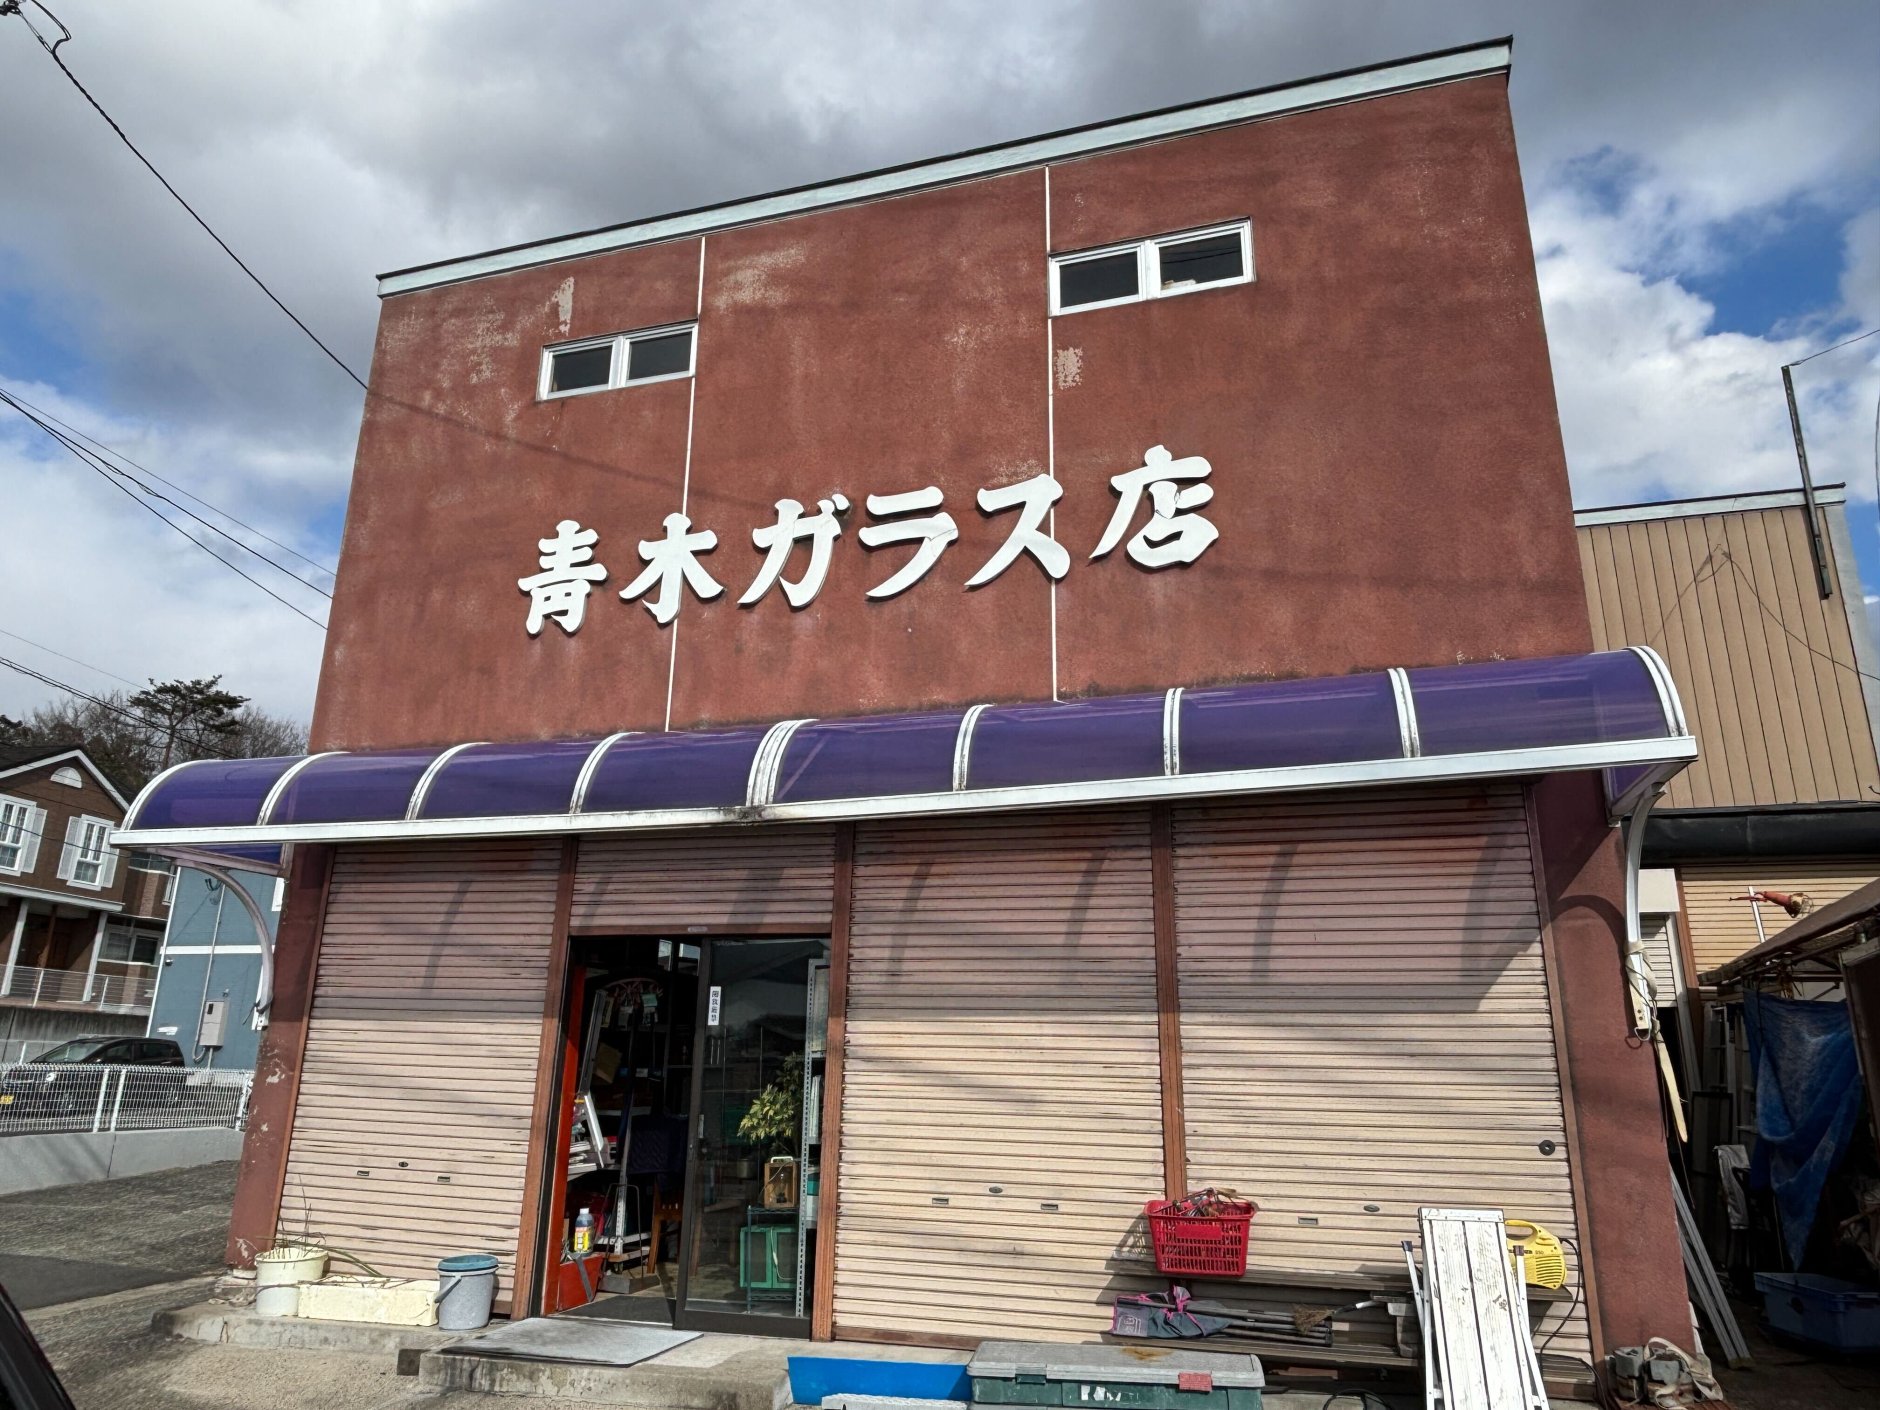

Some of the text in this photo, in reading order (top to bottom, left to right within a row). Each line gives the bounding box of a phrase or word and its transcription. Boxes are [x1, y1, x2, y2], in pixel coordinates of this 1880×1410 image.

[517, 444, 1220, 635] 青木ガラス店
